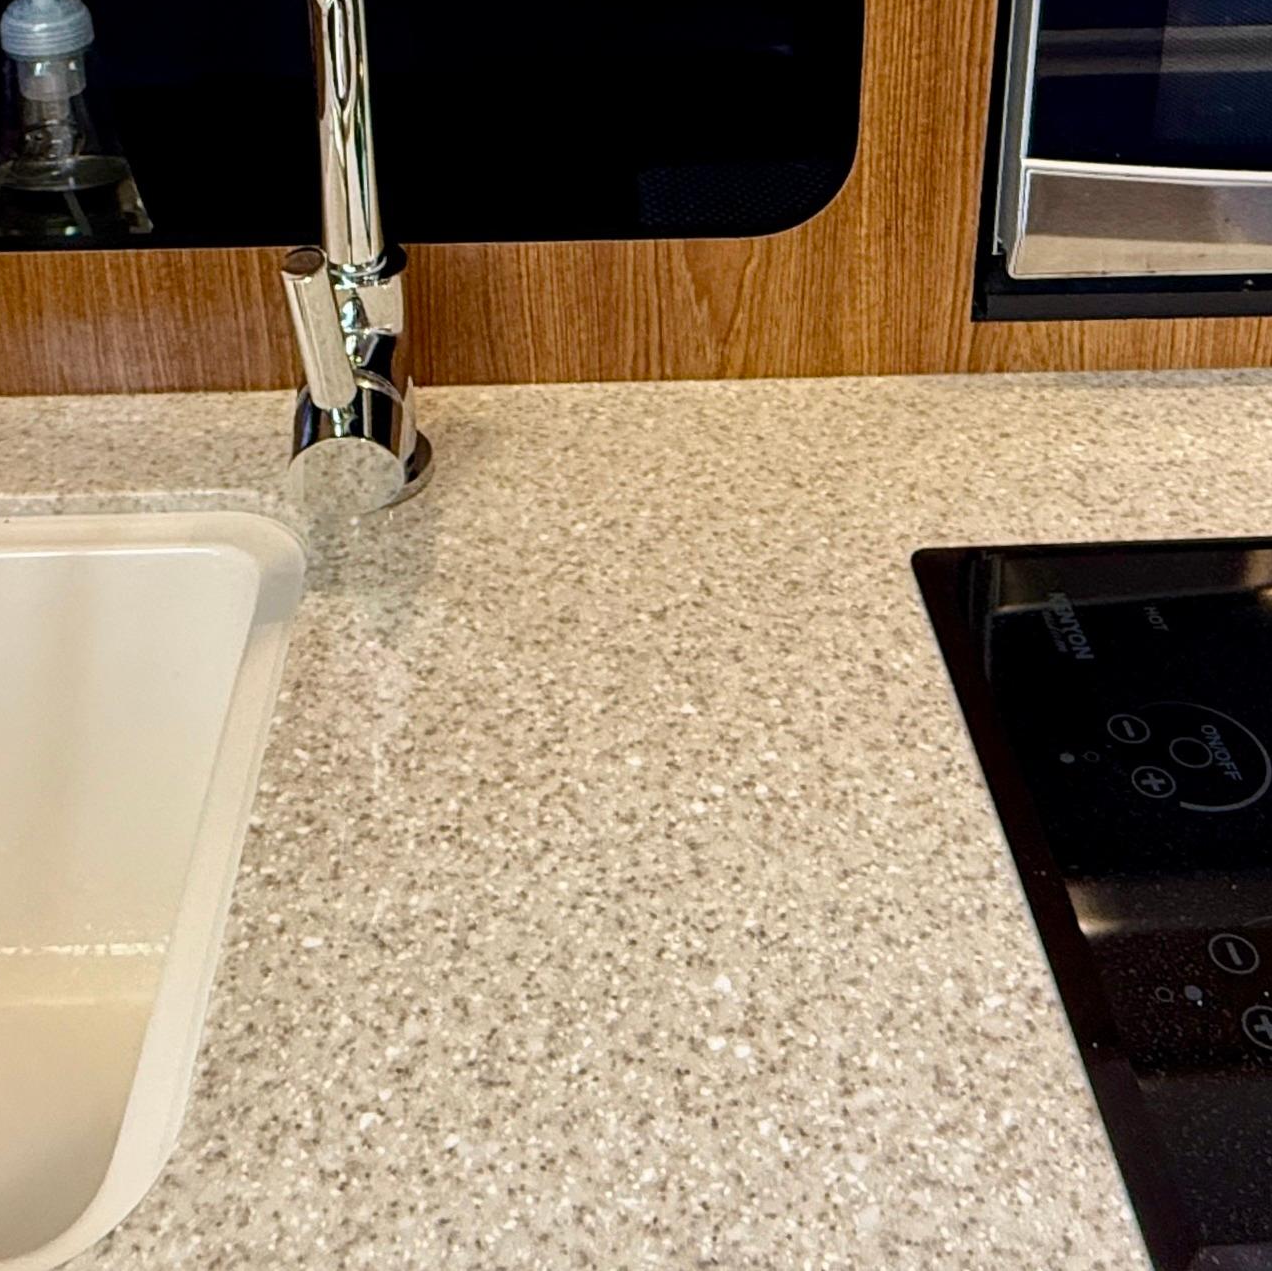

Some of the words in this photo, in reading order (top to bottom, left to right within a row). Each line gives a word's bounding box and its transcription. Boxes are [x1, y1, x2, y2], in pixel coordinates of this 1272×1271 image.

[1046, 591, 1096, 660] KENYON
[1143, 605, 1170, 632] HOT
[1201, 724, 1242, 782] ON/OFF
